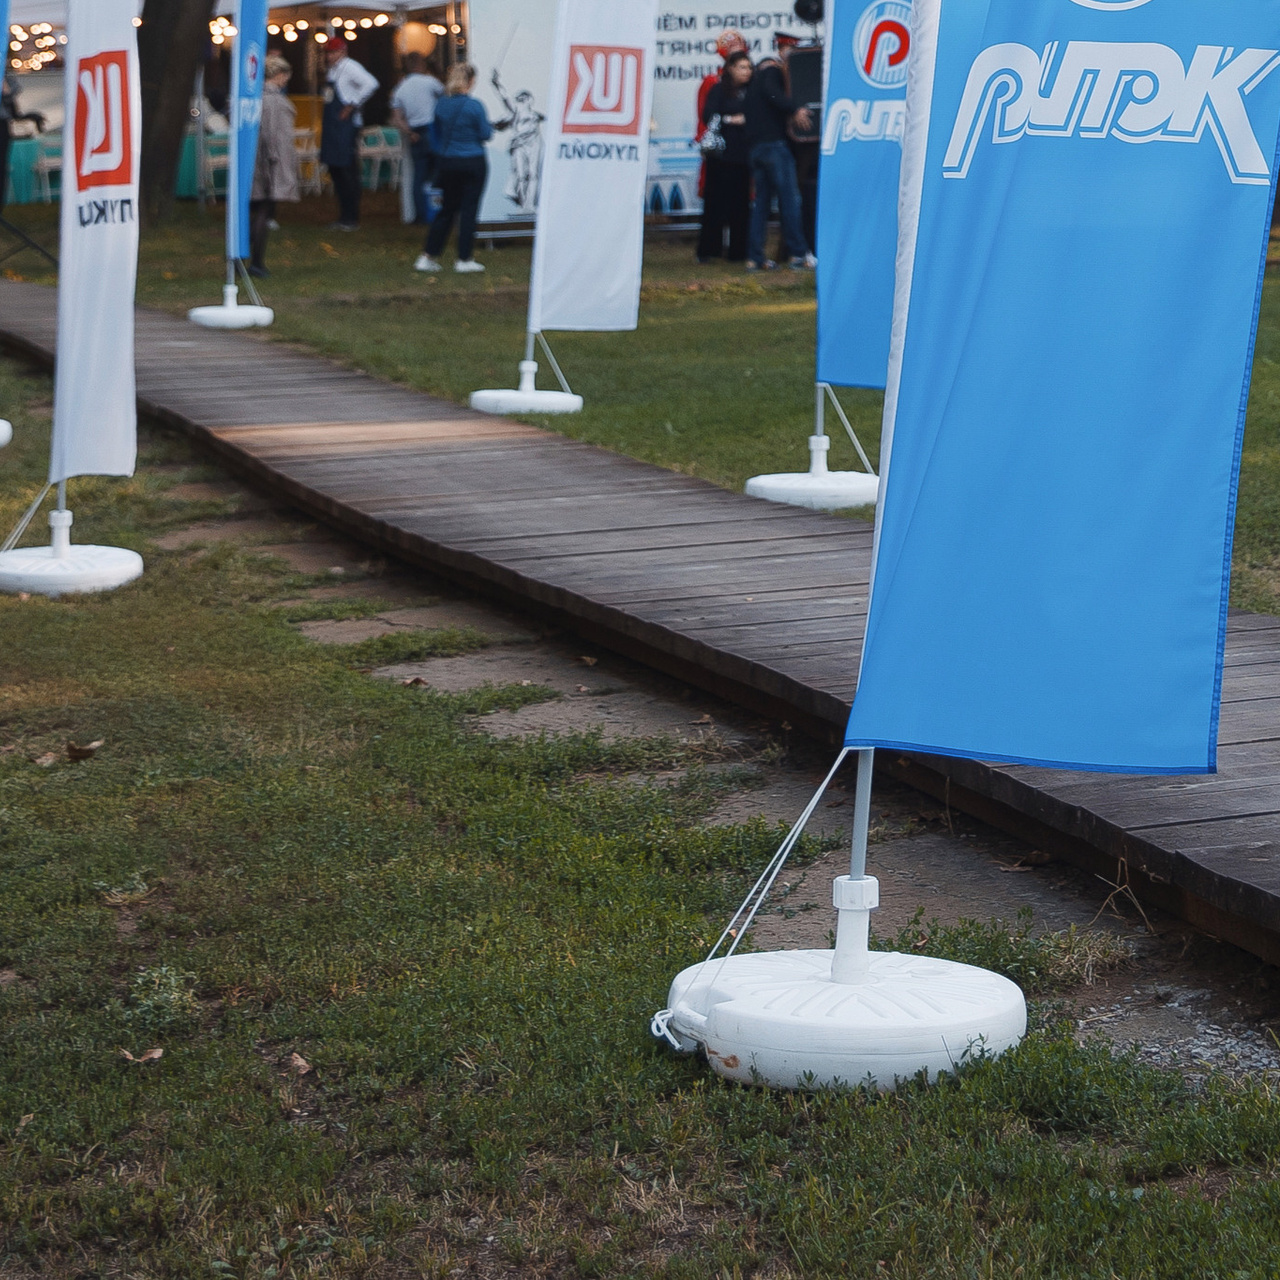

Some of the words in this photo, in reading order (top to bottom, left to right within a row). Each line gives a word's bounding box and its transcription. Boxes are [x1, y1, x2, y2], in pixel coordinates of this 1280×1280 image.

[656, 14, 697, 31] ЁМ
[706, 12, 806, 30] РАБОТН
[656, 39, 719, 56] ТЯНО
[654, 65, 717, 80] МЫШ
[822, 98, 906, 156] РИТ
